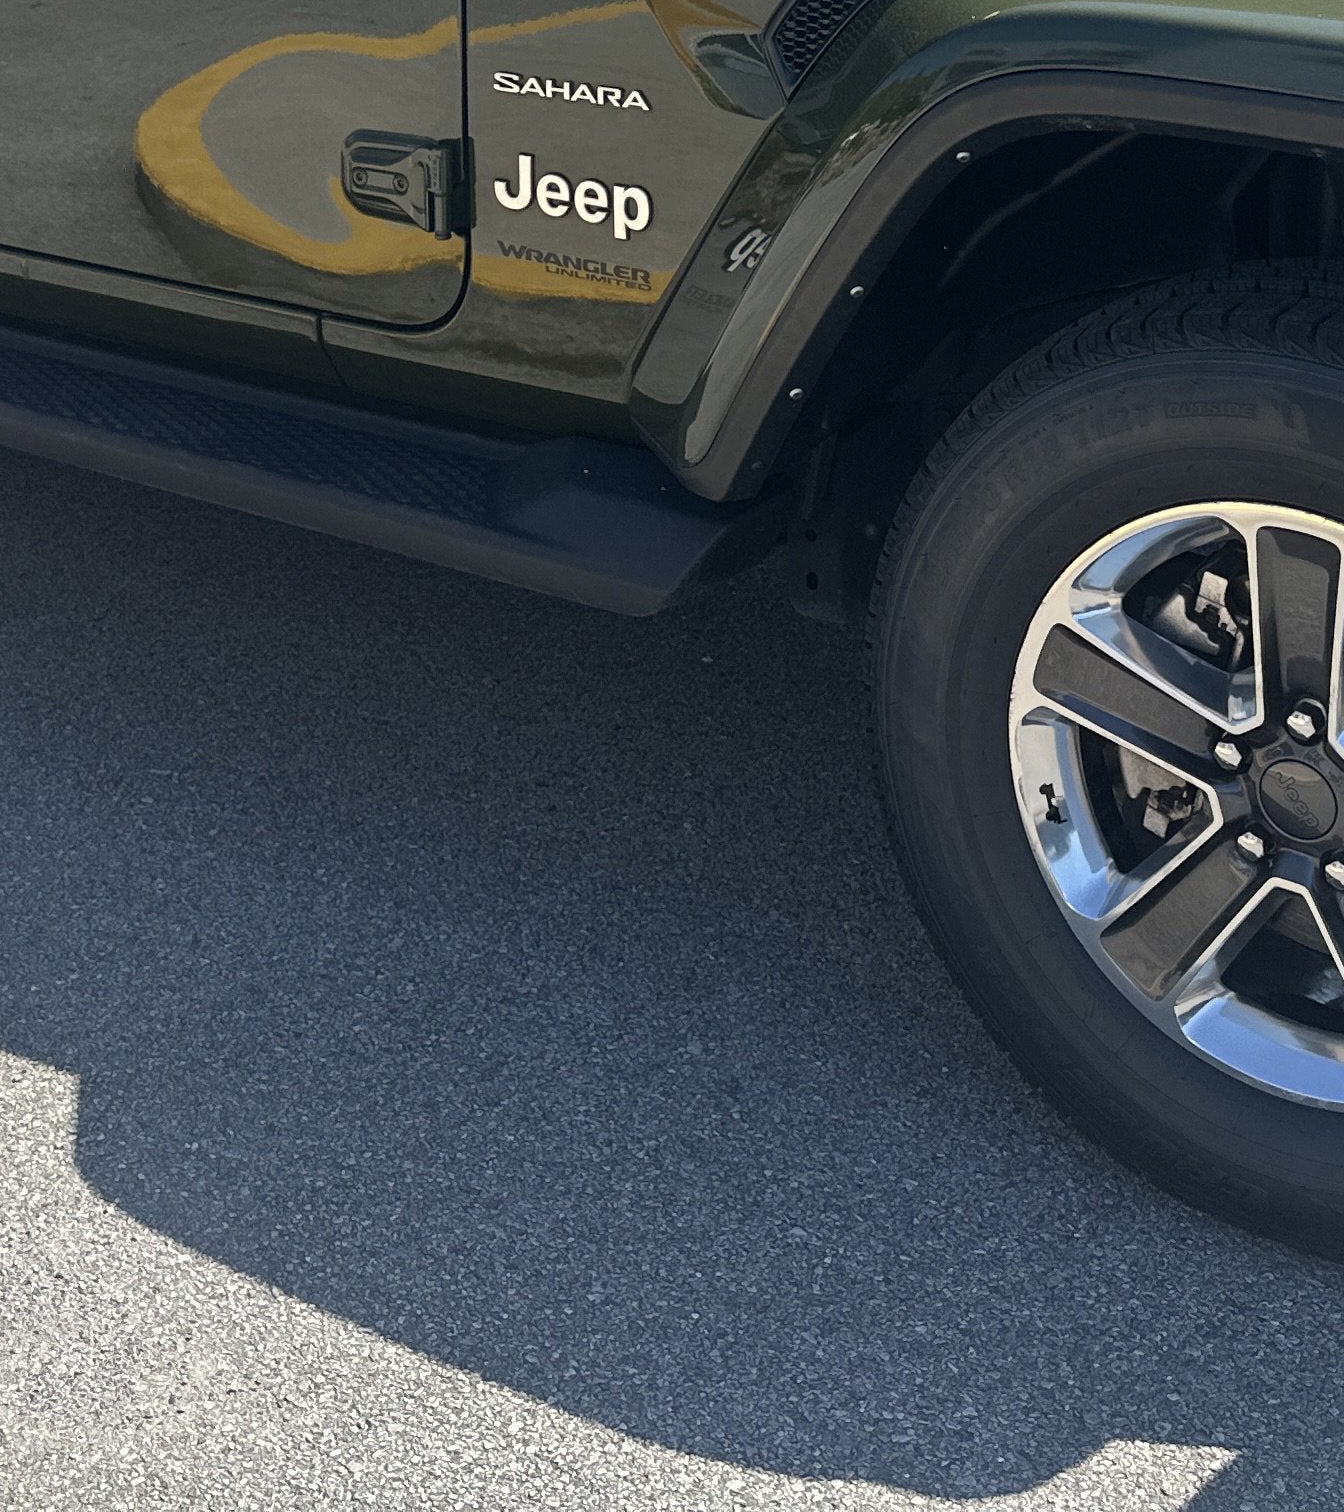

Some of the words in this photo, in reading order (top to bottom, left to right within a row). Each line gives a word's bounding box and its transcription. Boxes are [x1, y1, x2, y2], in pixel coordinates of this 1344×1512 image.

[493, 71, 651, 111] SAHARA
[494, 152, 654, 241] Jeep
[497, 240, 651, 284] WRANGLER
[545, 265, 652, 292] UNLIMITED
[1165, 400, 1256, 420] OUTSIDE
[1275, 772, 1320, 828] Jeep
